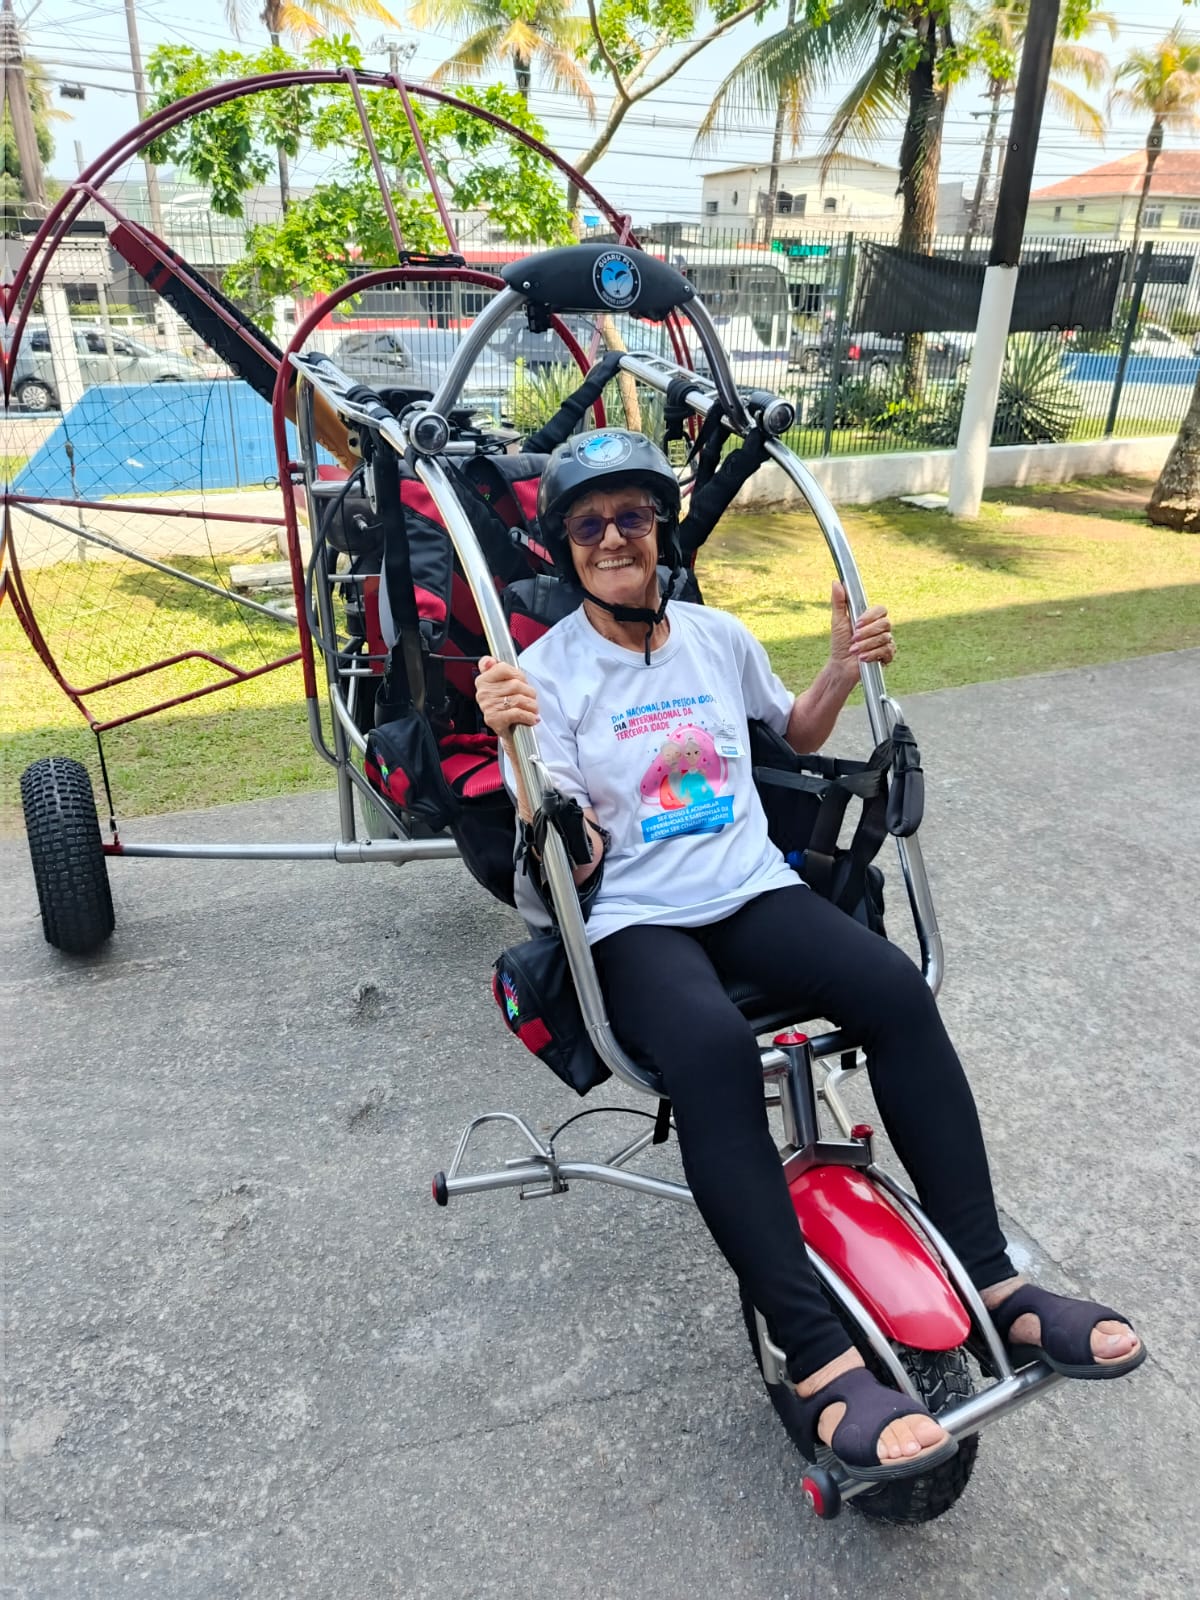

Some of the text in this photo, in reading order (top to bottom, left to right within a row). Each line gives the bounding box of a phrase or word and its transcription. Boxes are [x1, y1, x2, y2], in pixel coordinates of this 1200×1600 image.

[598, 254, 635, 270] GUARU FLY
[611, 713, 624, 724] DIA
[626, 702, 660, 717] NACIONAL
[661, 700, 671, 710] DA
[672, 697, 697, 708] PESSOA
[613, 707, 693, 733] DIA INTERNACIONAL DA
[615, 721, 670, 741] TERCEIRA IDADE
